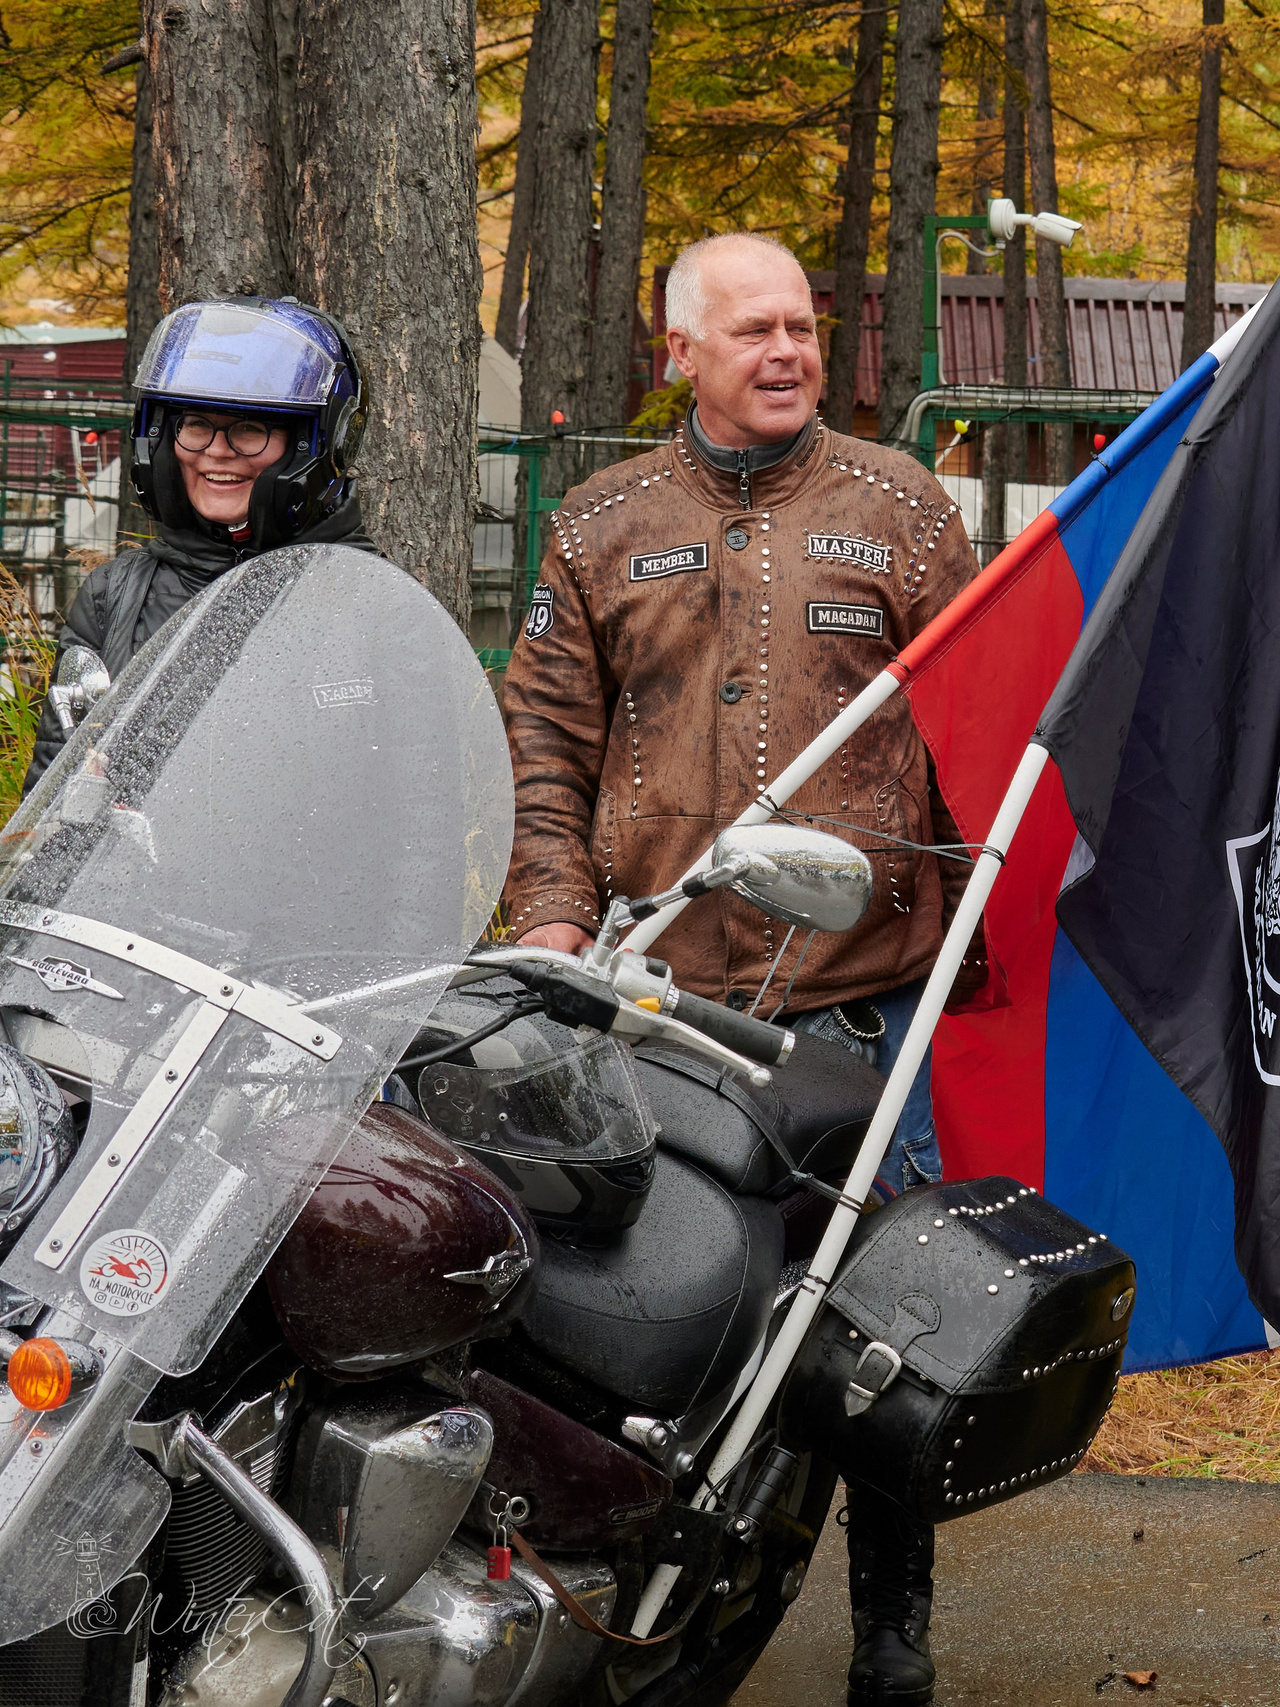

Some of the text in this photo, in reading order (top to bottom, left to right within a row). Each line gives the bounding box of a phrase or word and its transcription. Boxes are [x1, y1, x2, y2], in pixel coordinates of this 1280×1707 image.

[641, 551, 695, 573] MEMBER
[812, 538, 884, 566] MASTER
[526, 605, 549, 634] 49
[817, 609, 877, 629] MAGADAN
[31, 960, 90, 985] BOULEVARD
